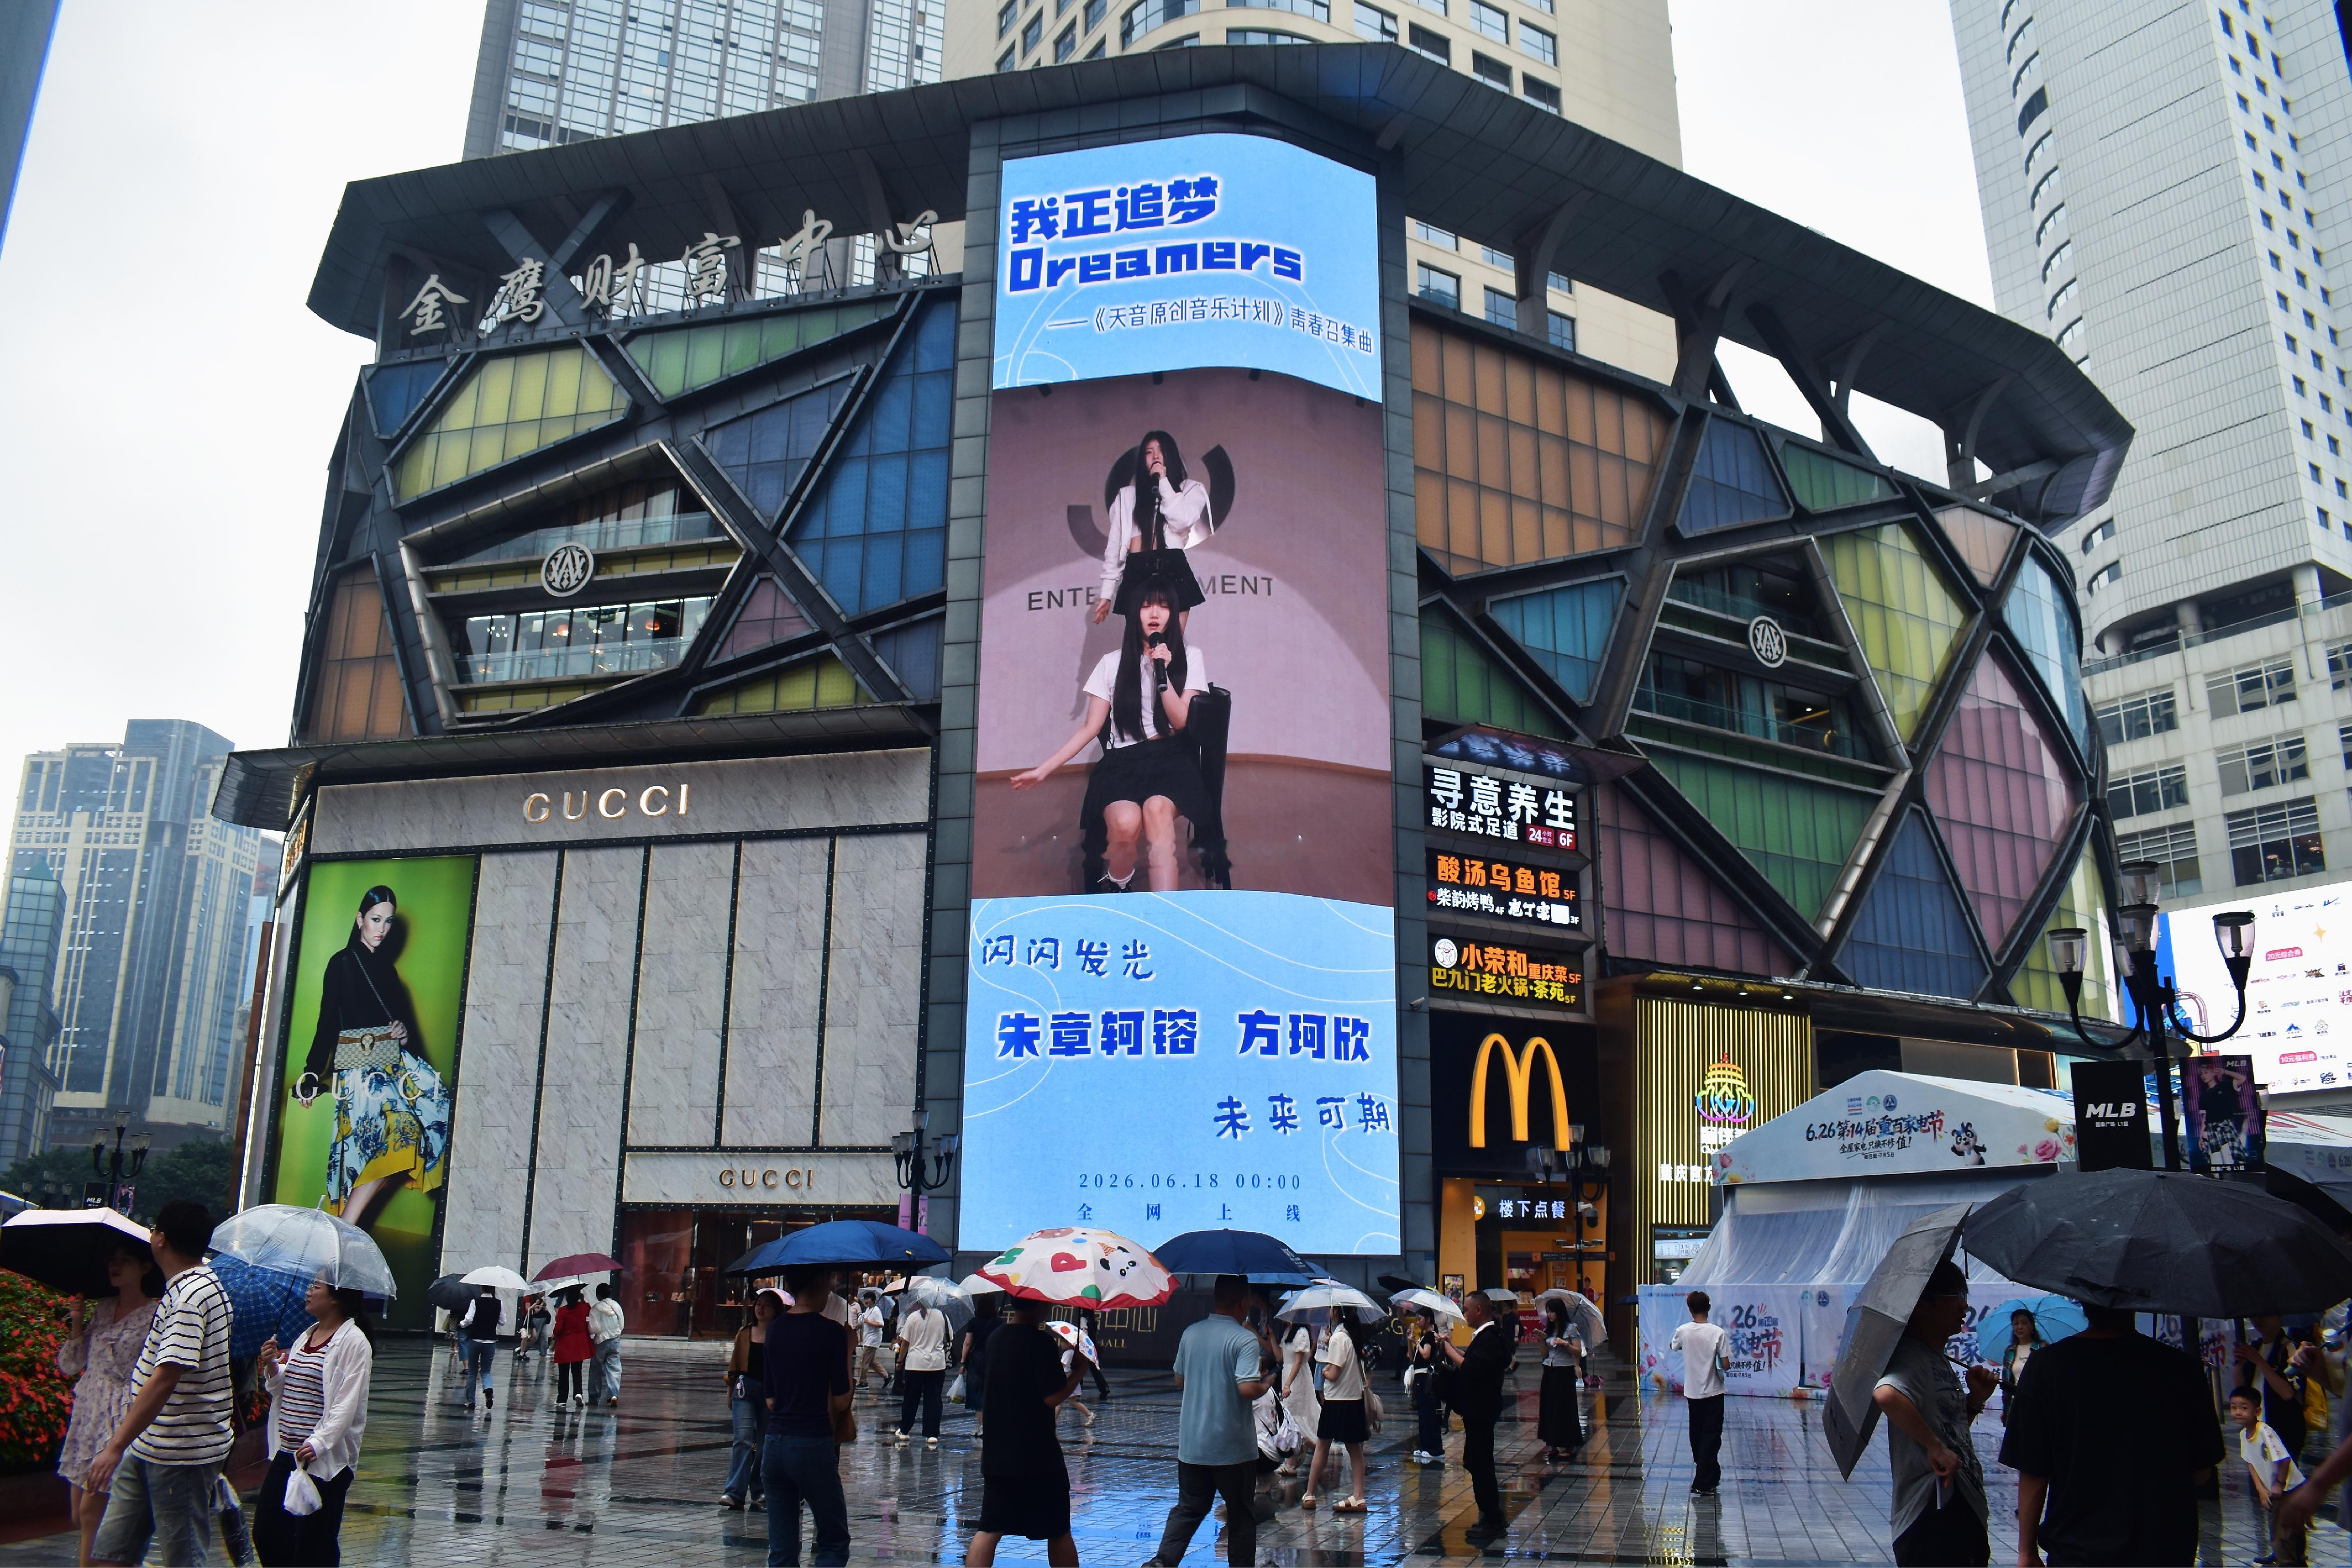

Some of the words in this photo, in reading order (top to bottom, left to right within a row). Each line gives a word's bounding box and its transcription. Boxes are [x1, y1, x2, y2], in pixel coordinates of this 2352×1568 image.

[1011, 176, 1218, 244] 我正追梦
[399, 208, 938, 336] 金鹰财富中心
[1009, 242, 1302, 292] Dreamers
[523, 783, 690, 823] GUCCI
[1430, 768, 1575, 830] 寻意养生
[1432, 807, 1518, 840] 影院式足道
[1559, 833, 1573, 847] 6F
[1437, 855, 1560, 898] 酸汤乌鱼馆
[1564, 889, 1576, 900] 5F
[1495, 906, 1504, 915] 4F
[1570, 915, 1579, 924] 3F
[982, 935, 1154, 979] 闪闪发光
[1461, 943, 1527, 977] 小荣和
[1528, 963, 1567, 983] 重庆菜
[1569, 973, 1581, 984] 5F
[1565, 995, 1576, 1004] 5F
[997, 1009, 1198, 1058] 朱章轲镕
[1238, 1010, 1371, 1062] 方珂欣
[295, 1072, 440, 1100] GUCCI
[1213, 1093, 1391, 1139] 未来可期
[2086, 1102, 2136, 1118] MLB
[719, 1169, 814, 1188] GUCCI
[1079, 1173, 1219, 1188] 2026.06.18
[1236, 1173, 1301, 1190] 00:00
[1499, 1199, 1565, 1219] 楼下点餐
